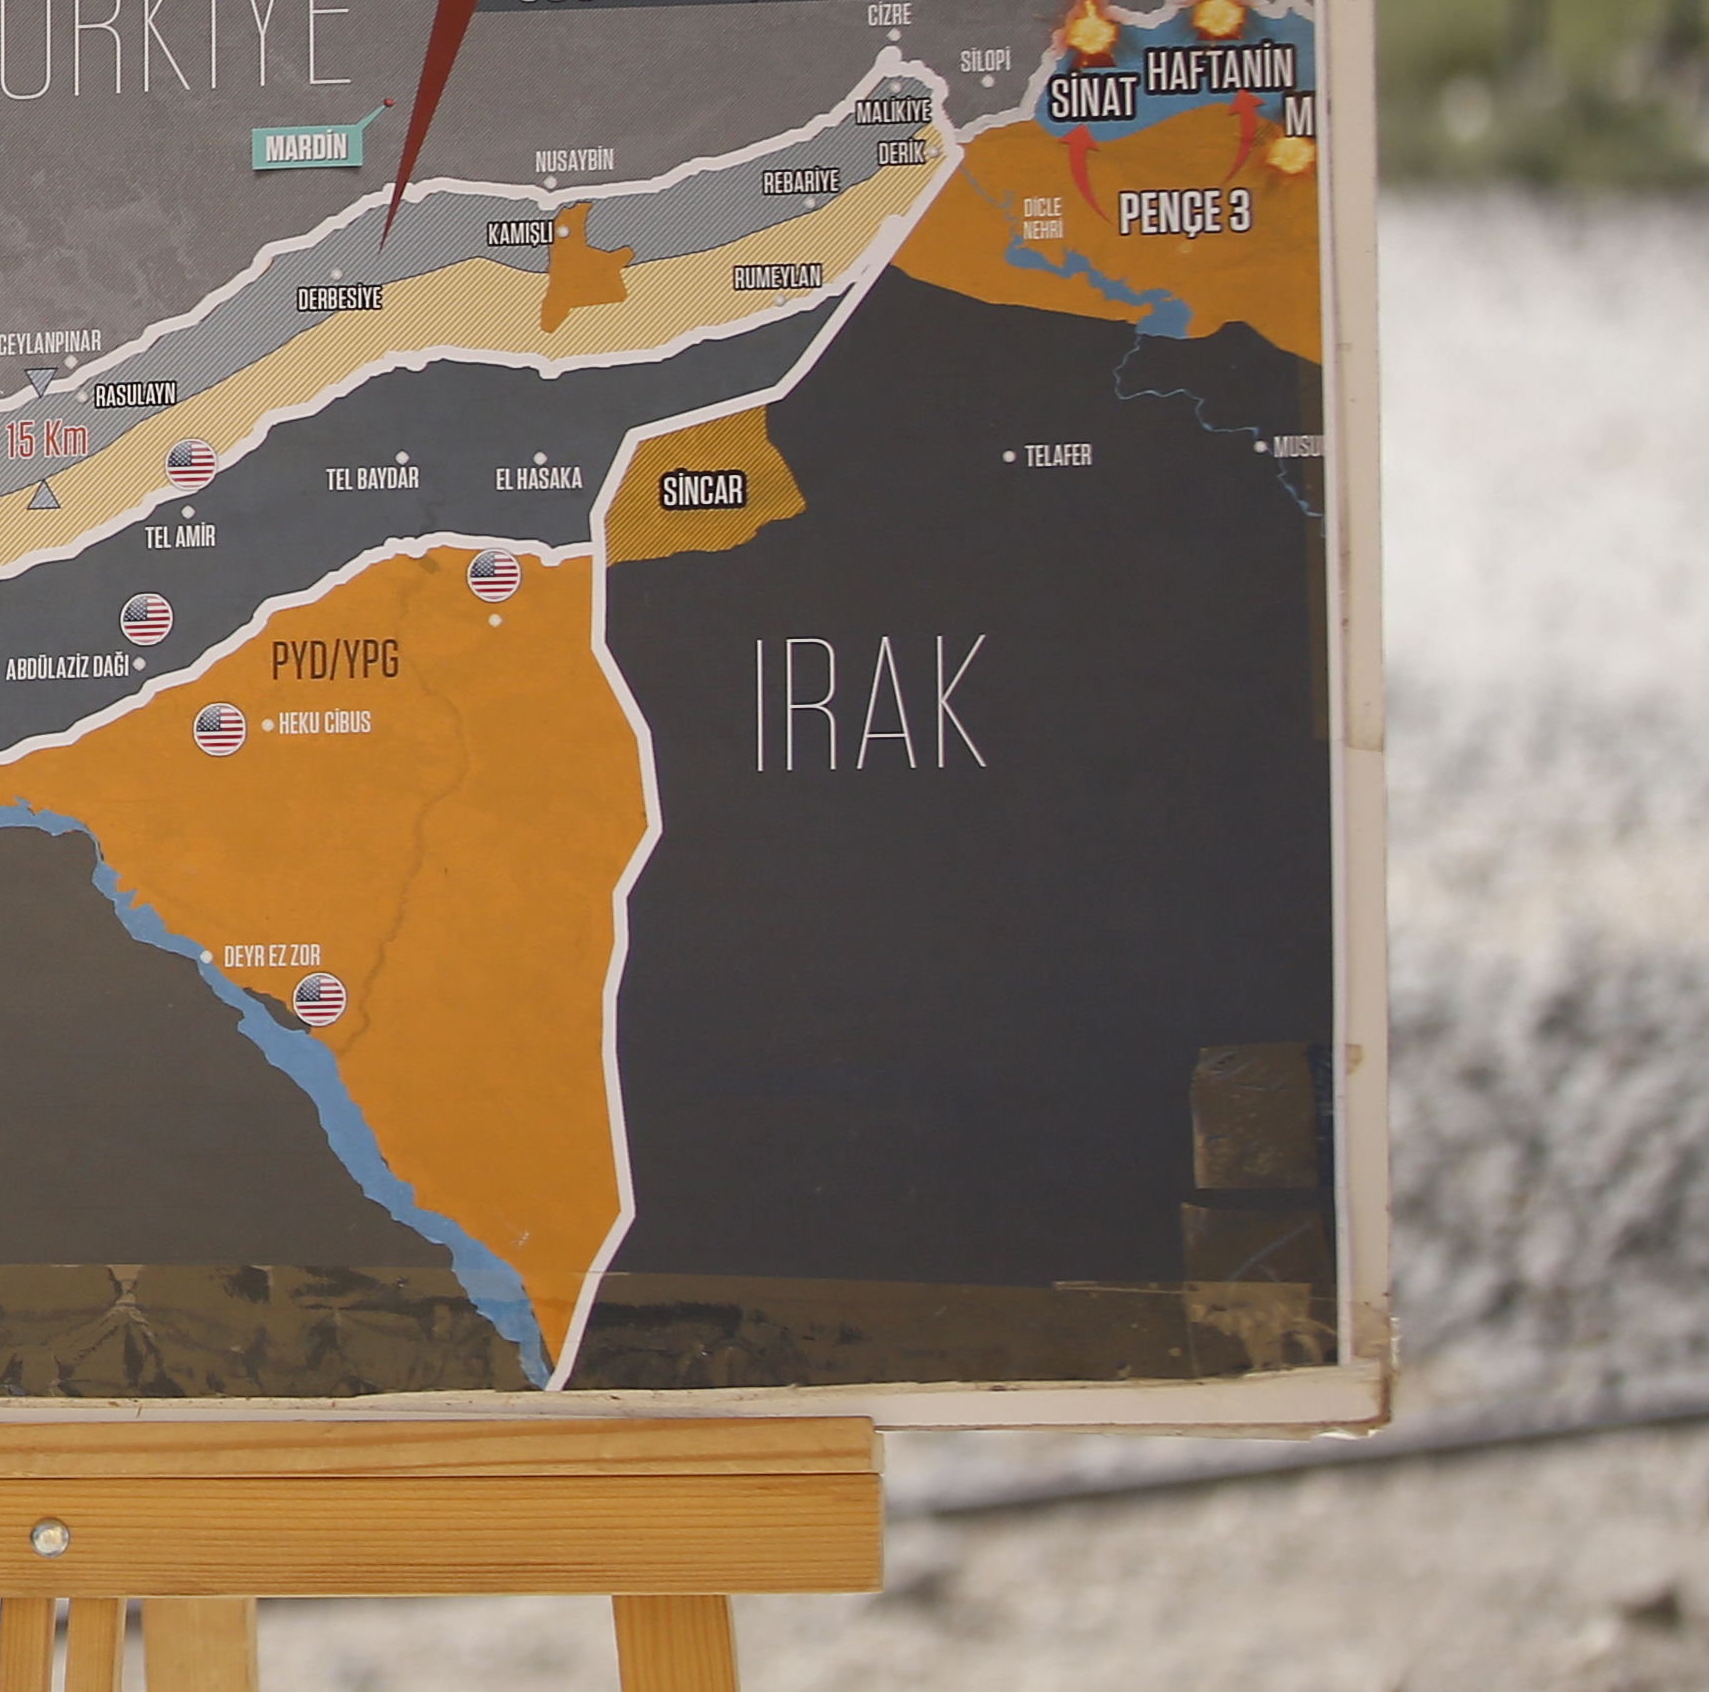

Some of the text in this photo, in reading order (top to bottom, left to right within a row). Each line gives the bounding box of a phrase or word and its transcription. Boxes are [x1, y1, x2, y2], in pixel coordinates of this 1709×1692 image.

[867, 1, 912, 26] CİZRE
[960, 46, 1011, 73] SİLOPİ
[1146, 41, 1293, 89] HAFTANİN
[856, 97, 931, 123] MALİKİYE
[1050, 74, 1137, 119] SİNAT
[265, 128, 348, 162] MARDİN
[878, 139, 925, 165] DERİK
[536, 146, 614, 173] NUSAYBİN
[763, 167, 839, 194] REBARİYE
[1120, 189, 1251, 237] PENÇE 3
[488, 221, 554, 247] KAMIŞLI
[734, 265, 821, 290] RUMEYLAN
[299, 283, 381, 310] DERBESİYE
[95, 382, 177, 408] RASULAYN
[6, 419, 88, 459] 15 Km
[1025, 443, 1092, 467] TELAFER
[326, 466, 419, 491] TEL BAYDAR
[496, 466, 583, 491] EL HASAKA
[663, 472, 743, 506] SİNCAR
[145, 522, 216, 549] TEL AMİR
[6, 653, 129, 681] ABDÜLAZİZ DAĞI
[271, 638, 400, 681] PYD/YPG
[756, 634, 987, 772] IRAK
[279, 708, 371, 734] HEKU CİBUS
[225, 944, 320, 967] DEYR EZ ZOR
